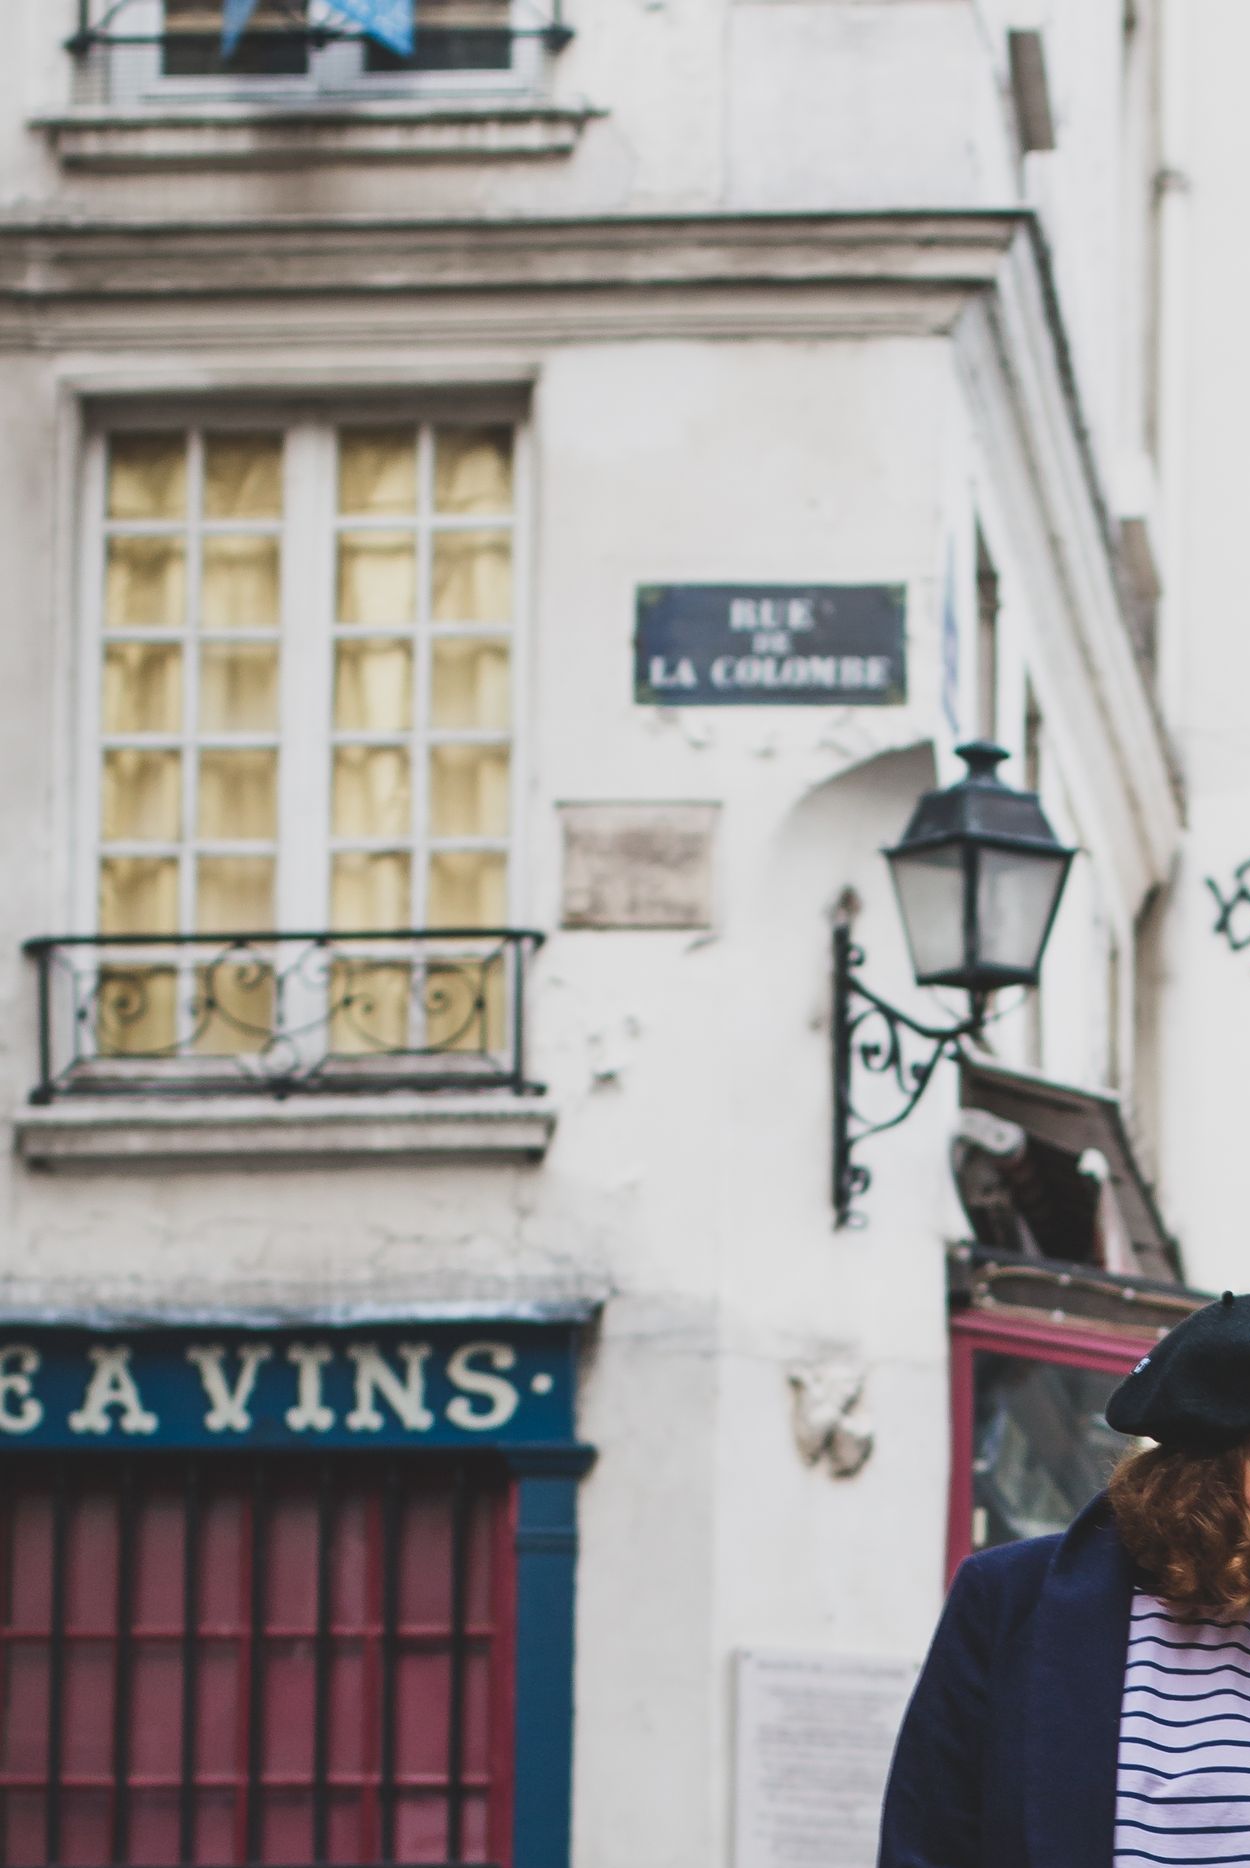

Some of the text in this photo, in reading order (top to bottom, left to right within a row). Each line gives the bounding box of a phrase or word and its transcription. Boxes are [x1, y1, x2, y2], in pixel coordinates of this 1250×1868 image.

[729, 597, 815, 631] RUE
[751, 631, 792, 653] DE
[649, 656, 892, 689] LA COLOMBE
[68, 1345, 160, 1435] A
